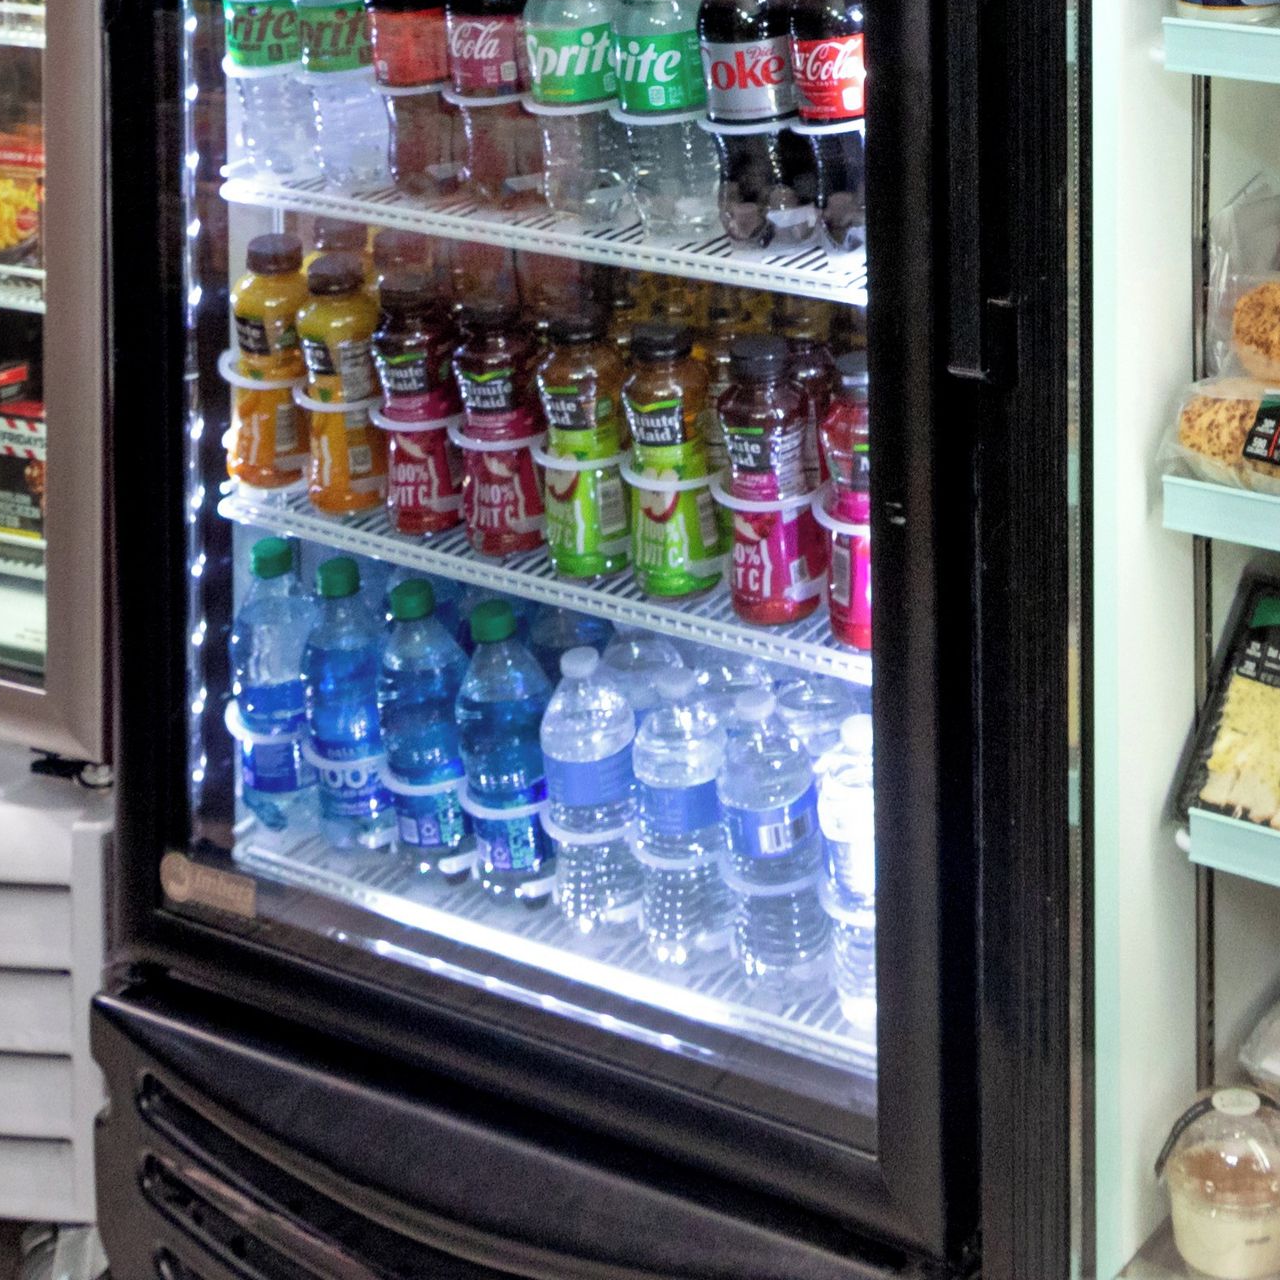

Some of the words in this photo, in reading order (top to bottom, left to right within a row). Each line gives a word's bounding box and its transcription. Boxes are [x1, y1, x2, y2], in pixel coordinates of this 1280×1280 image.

[231, 5, 297, 44] rite
[525, 30, 611, 85] Sprit
[617, 41, 682, 82] rite
[711, 51, 786, 91] oke
